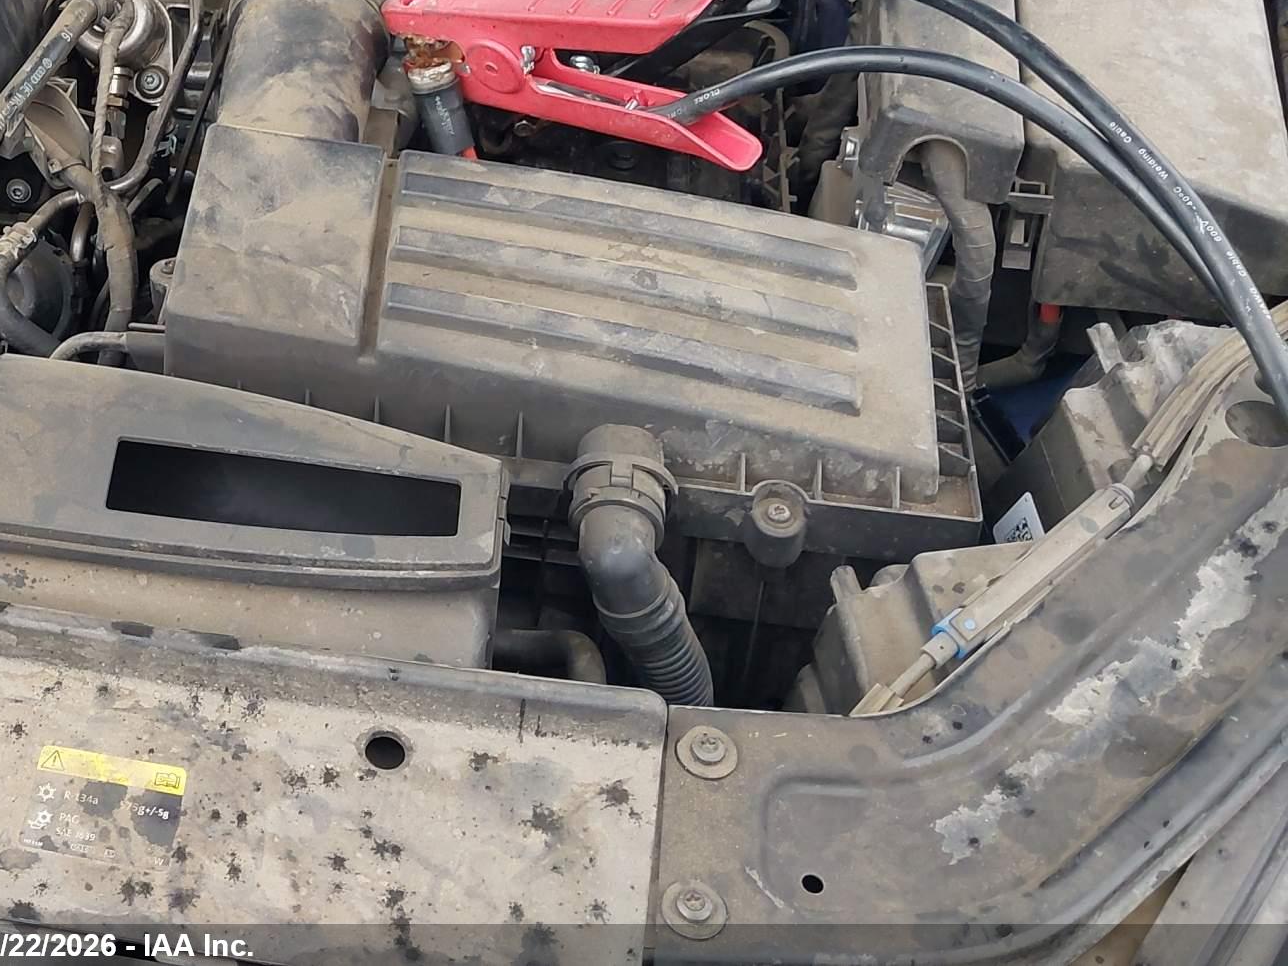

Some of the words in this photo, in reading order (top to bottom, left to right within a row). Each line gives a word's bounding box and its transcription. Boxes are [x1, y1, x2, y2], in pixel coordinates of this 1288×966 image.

[1109, 121, 1133, 145] Cable
[1138, 147, 1169, 181] Welding
[1227, 251, 1247, 277] Cable
[58, 812, 80, 825] PAG
